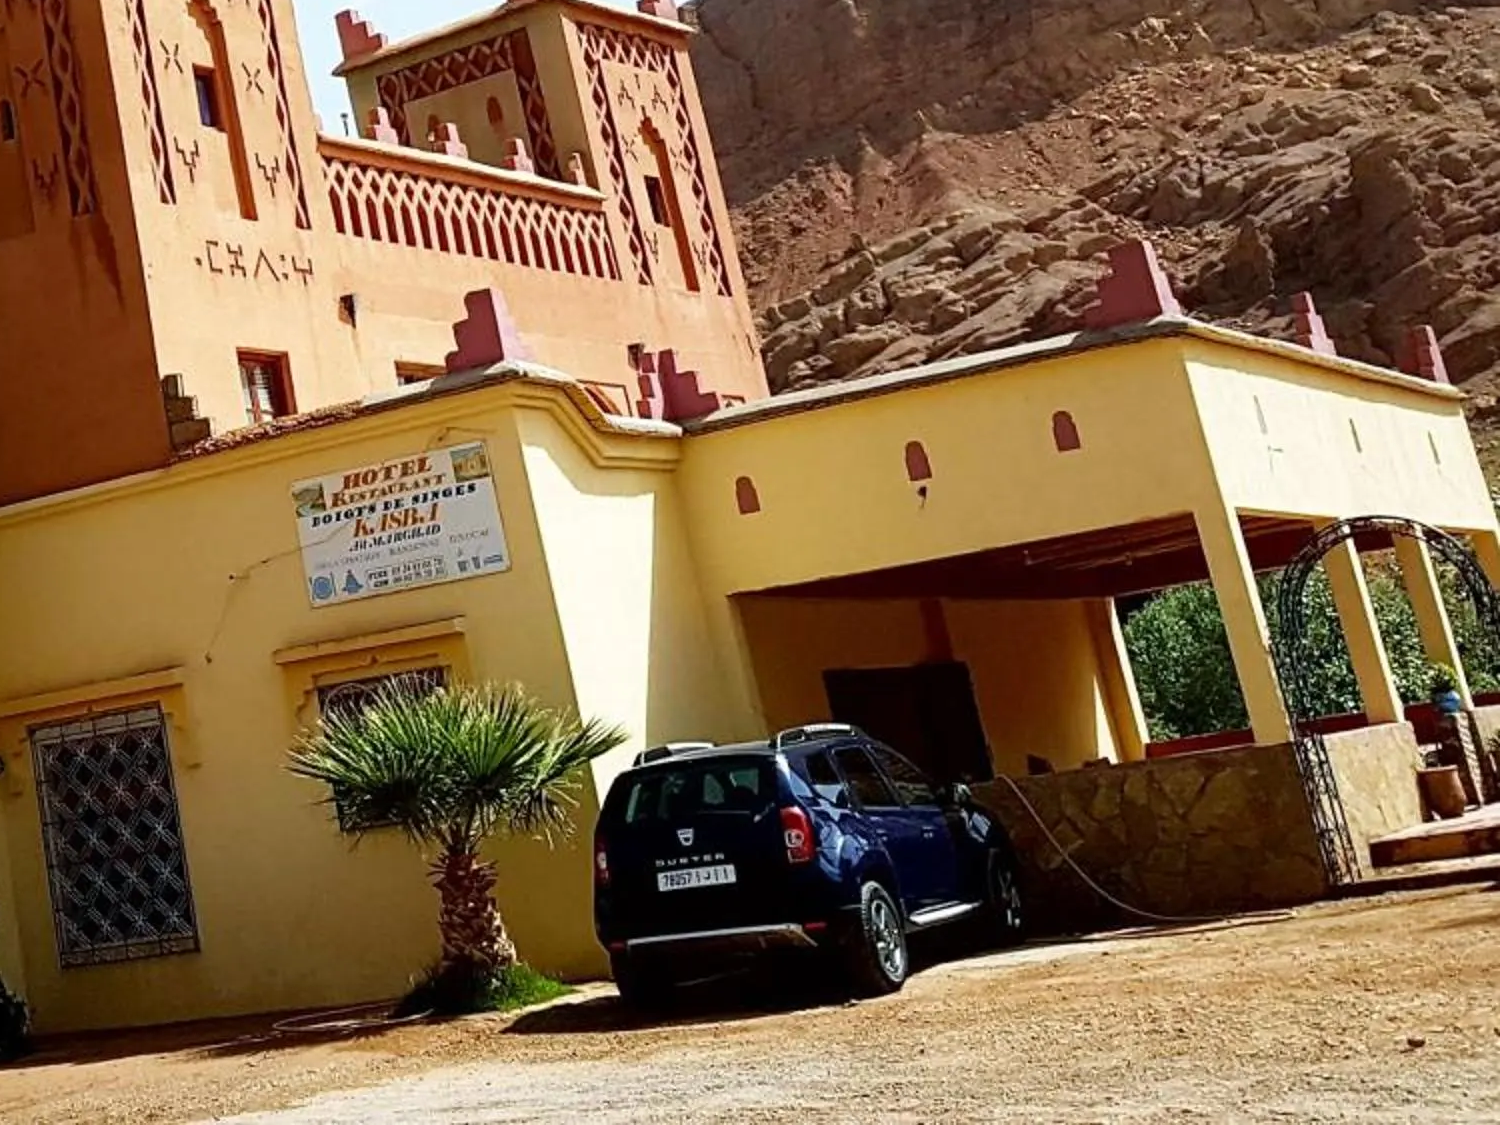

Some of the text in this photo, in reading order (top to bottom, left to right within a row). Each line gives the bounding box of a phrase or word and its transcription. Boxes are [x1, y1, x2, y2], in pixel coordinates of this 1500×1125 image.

[341, 456, 433, 491] HOTEL
[383, 495, 405, 511] DE
[411, 482, 477, 505] SINGES
[655, 853, 725, 868] DUSTER
